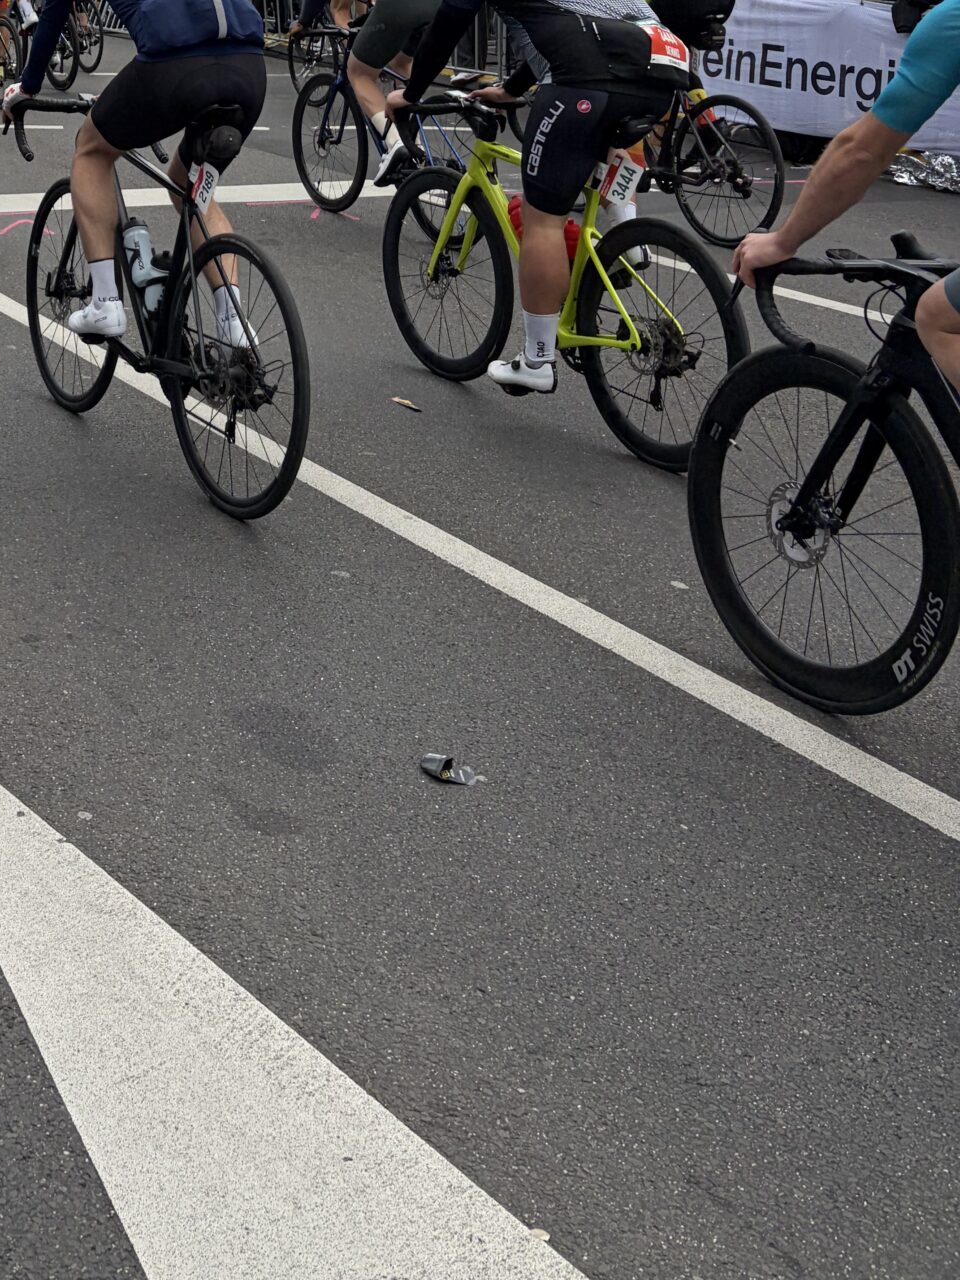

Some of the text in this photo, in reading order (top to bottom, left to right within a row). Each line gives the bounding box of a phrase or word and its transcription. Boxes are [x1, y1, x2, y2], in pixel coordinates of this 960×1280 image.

[198, 171, 214, 203] 2189
[611, 165, 637, 200] 3444
[536, 341, 545, 358] CIAO
[892, 647, 915, 683] DT
[913, 592, 944, 656] SWISS
